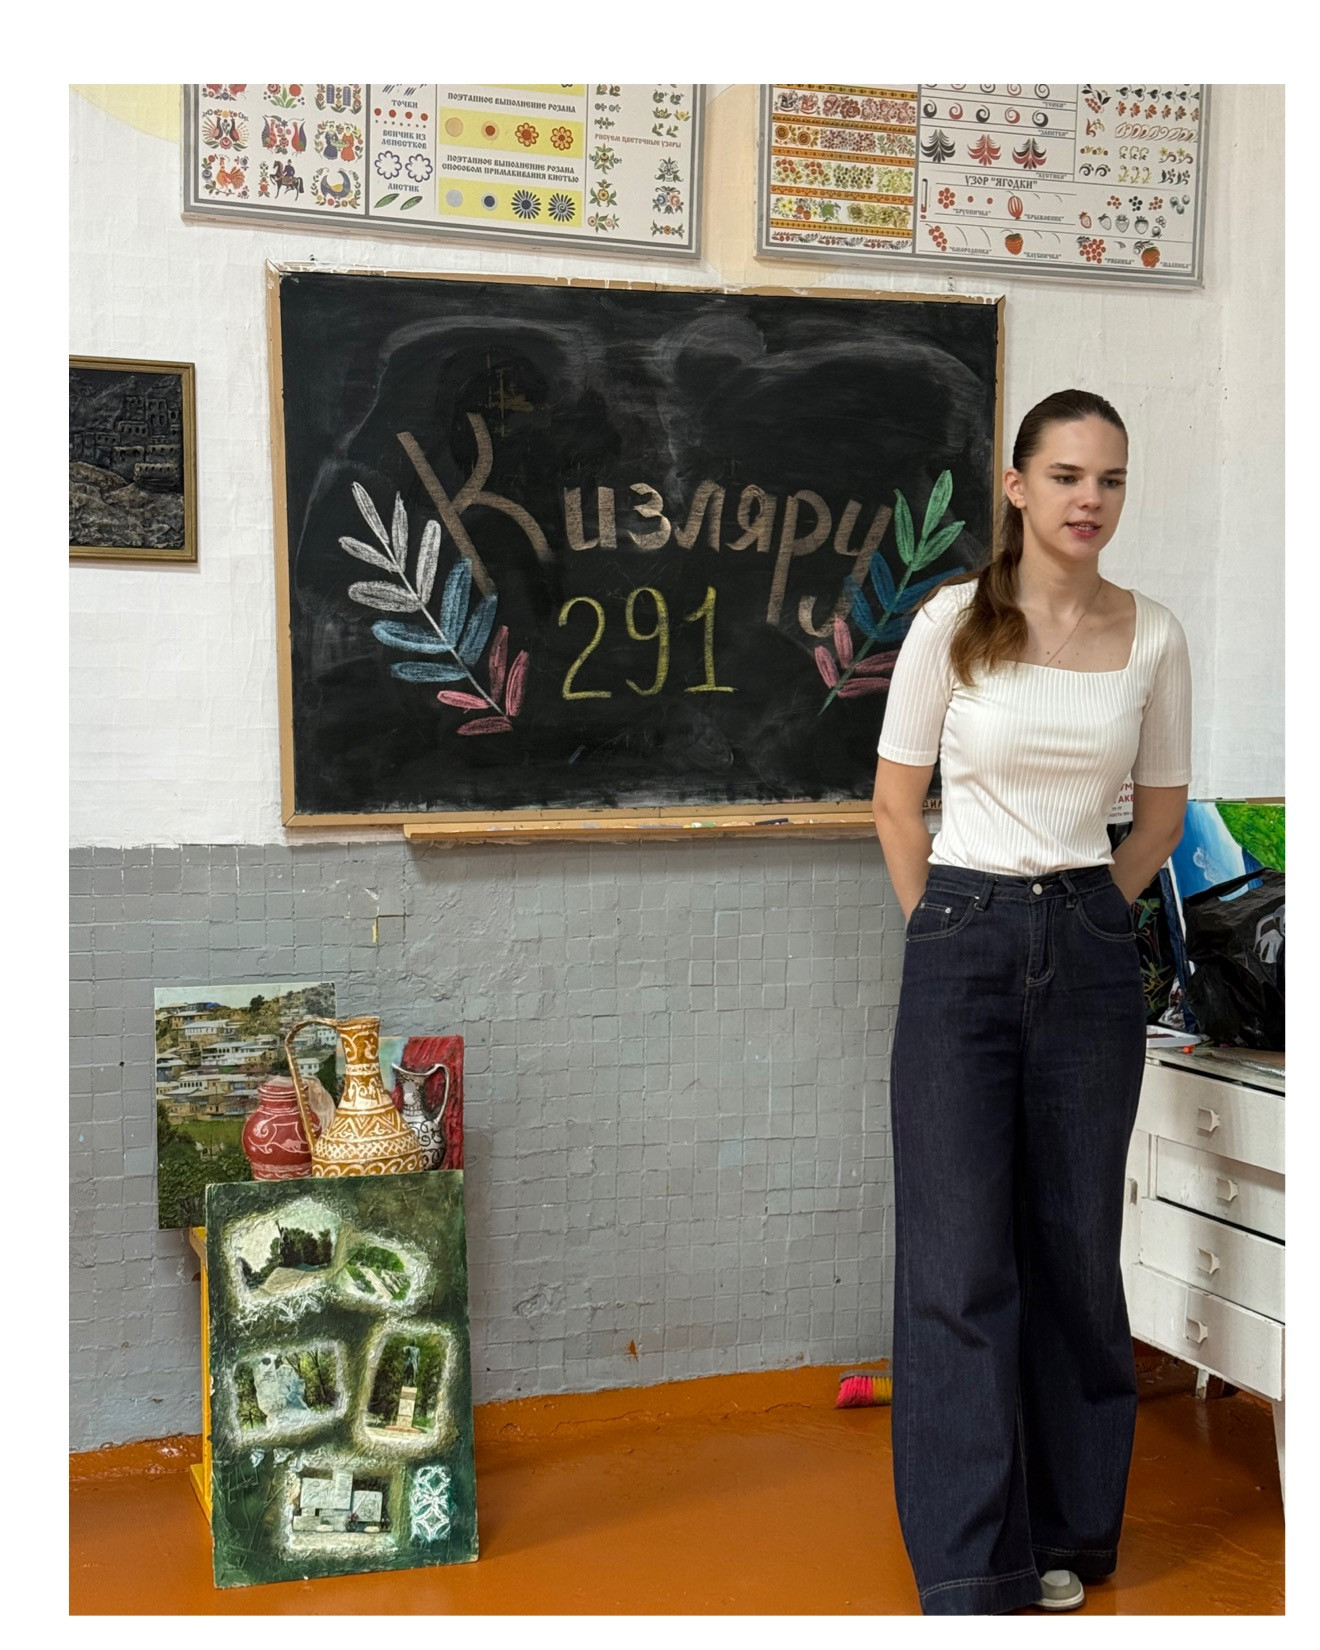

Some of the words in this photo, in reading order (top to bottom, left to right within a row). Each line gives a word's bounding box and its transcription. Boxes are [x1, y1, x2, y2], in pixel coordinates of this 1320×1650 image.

[391, 99, 418, 109] ТОЧКИ
[447, 92, 493, 105] ПОЭТАПНОЕ
[494, 97, 546, 111] ВЫПОЛНЕНИЕ
[547, 103, 576, 113] РОЗАНА
[382, 129, 414, 142] ВЕНЧИК
[415, 133, 427, 141] ИЗ
[595, 133, 621, 144] РИСУЕМ
[621, 136, 660, 147] ЦВЕТОЧНЫЕ
[381, 138, 427, 150] ЛЕПЕСТКОВ
[447, 154, 493, 167] ПОЭТАПНОЕ
[493, 158, 546, 171] ВЫПОЛНЕНИЕ
[546, 164, 575, 174] РОЗАНА
[441, 163, 483, 175] СПОСОБОМ
[484, 167, 546, 181] ПРИМАКИВАНИЯ
[547, 173, 580, 184] КИСТЬЮ
[387, 182, 420, 193] ЛИСТИК
[965, 175, 989, 186] УЗОР
[990, 177, 1038, 190] "ЯГОДКИ"
[397, 412, 892, 638] Кизляру
[558, 585, 737, 701] 291
